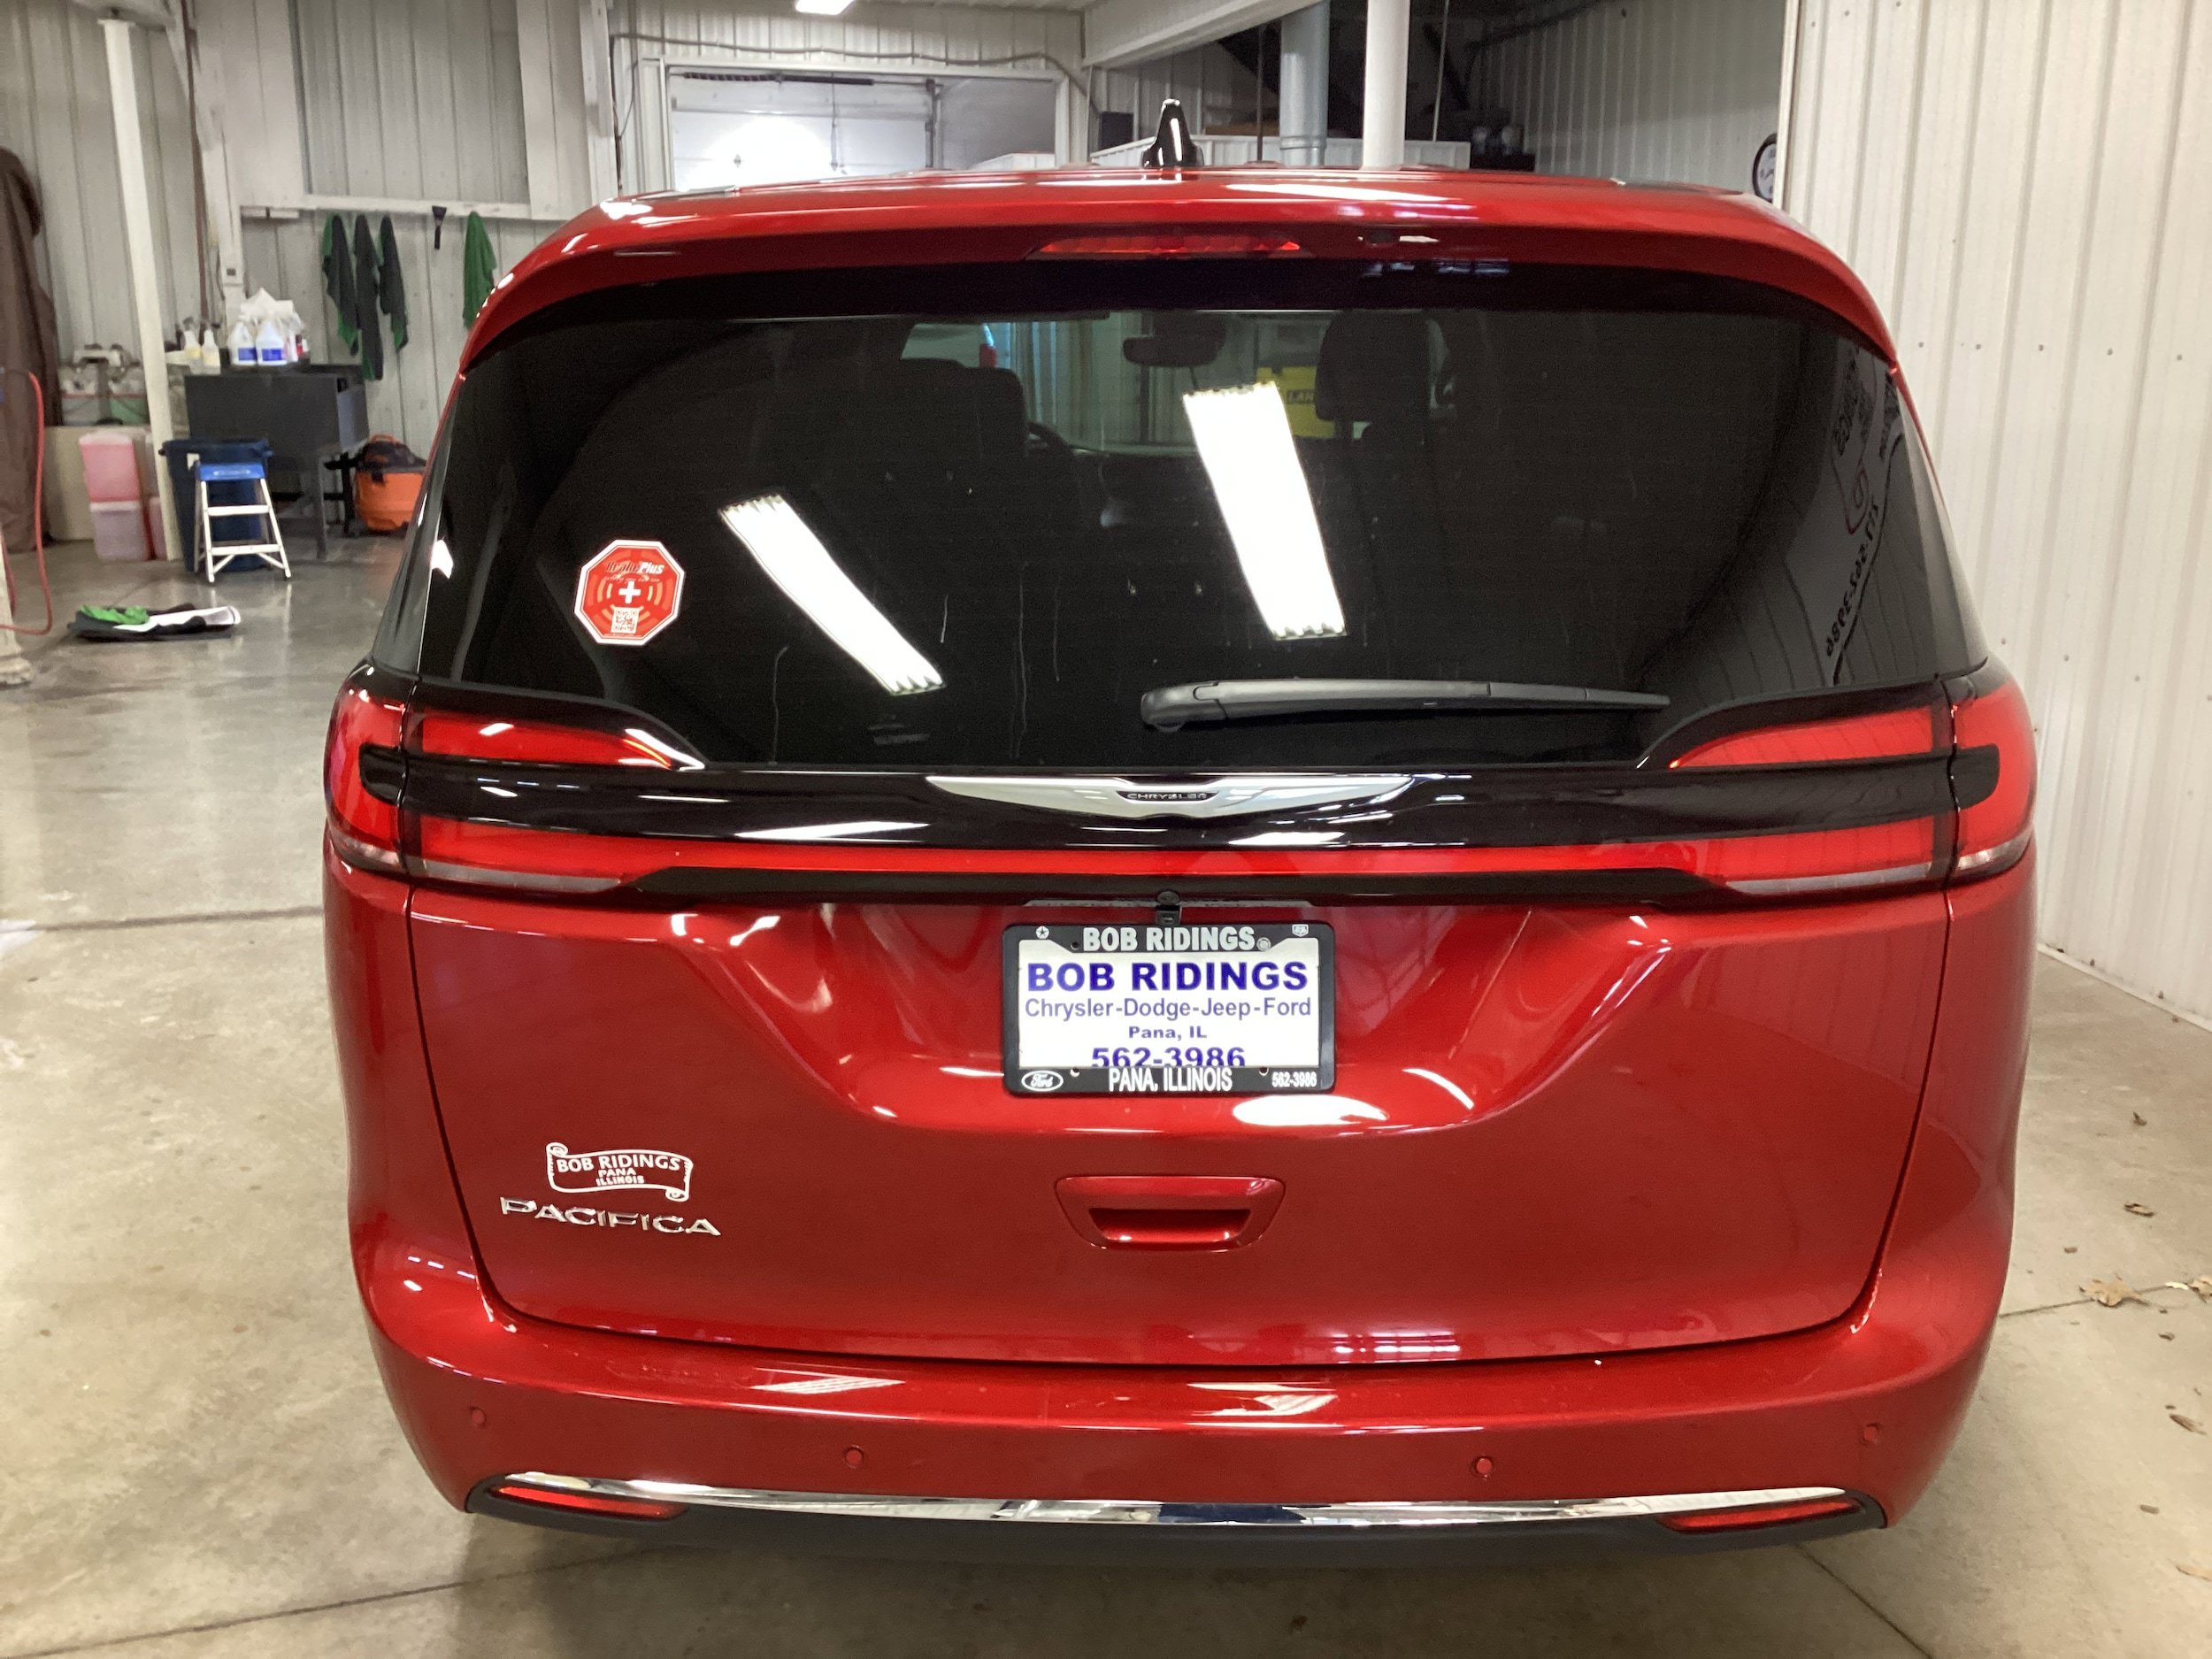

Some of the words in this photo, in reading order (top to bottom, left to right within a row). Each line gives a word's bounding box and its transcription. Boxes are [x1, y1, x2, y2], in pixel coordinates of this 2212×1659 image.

[1083, 927, 1138, 951] BOB
[1146, 926, 1256, 951] RIDINGS
[1027, 963, 1116, 992] BOB
[1131, 962, 1308, 991] RIDINGS
[1128, 1026, 1182, 1041] Pana,
[1189, 1025, 1208, 1039] IL
[1091, 1048, 1246, 1068] 562-3986
[1109, 1068, 1158, 1092] PANA,
[1163, 1068, 1233, 1091] ILLINOIS
[1271, 1071, 1317, 1087] 562-3986
[557, 1157, 594, 1172] BOB
[598, 1155, 680, 1171] RIDINGS
[595, 1176, 644, 1186] ILLINOIS
[598, 1168, 636, 1178] PANA
[500, 1196, 721, 1236] PACIFICA
